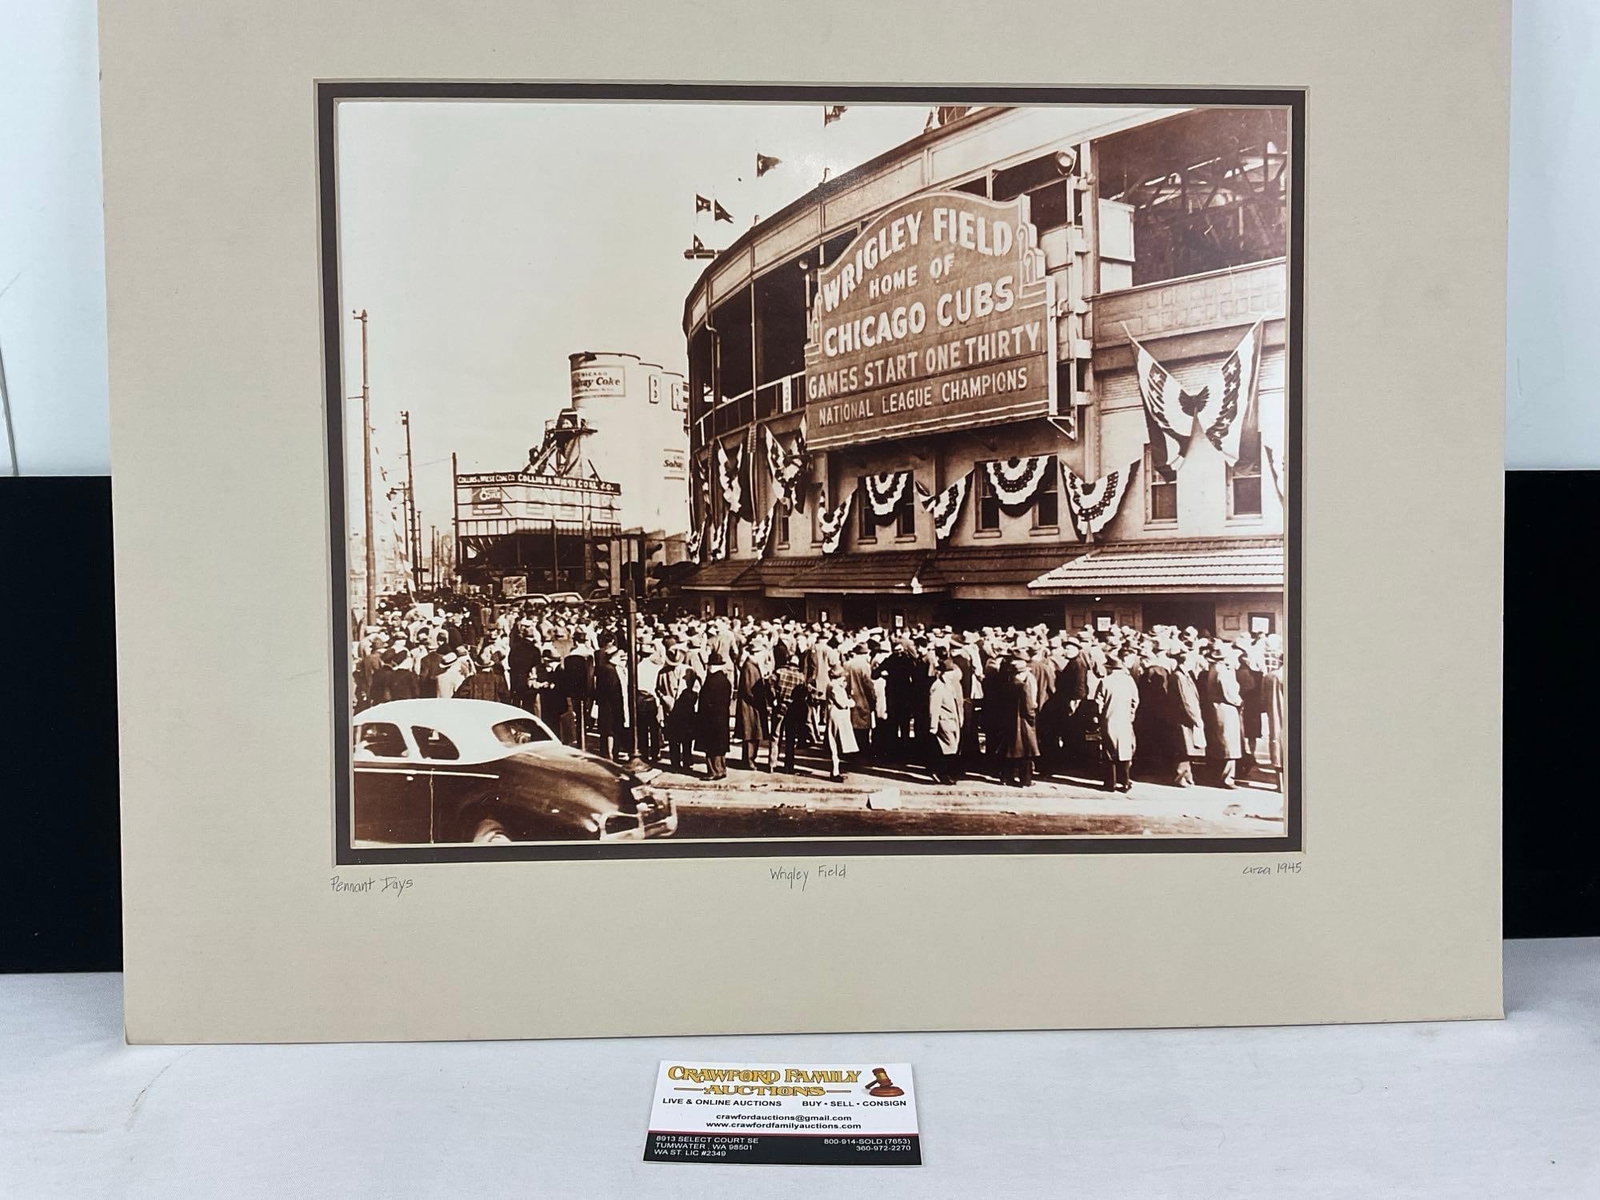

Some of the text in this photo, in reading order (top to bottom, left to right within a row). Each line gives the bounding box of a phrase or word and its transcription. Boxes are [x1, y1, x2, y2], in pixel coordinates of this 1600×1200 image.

[822, 207, 1013, 312] WRIGLEY FIELD
[868, 253, 955, 298] HOME OF
[823, 275, 1015, 357] CHICAGO CUBS
[808, 321, 1041, 400] GAMES START ONE THIRTY
[596, 376, 621, 386] Coke
[819, 366, 1028, 427] NATIONAL LEAGUE CHAMPIONS
[578, 480, 598, 490] COAL
[769, 863, 846, 892] Wrigley Field
[1242, 862, 1302, 875] circa 1945
[330, 875, 414, 898] Pennant Days
[668, 1065, 862, 1085] CRAWFORD FAMILY
[703, 1085, 826, 1097] AUCTIONS
[706, 1121, 862, 1130] www.crawfordfamilyauctions.com
[716, 1113, 852, 1123] crawfordauctions@gmail.com
